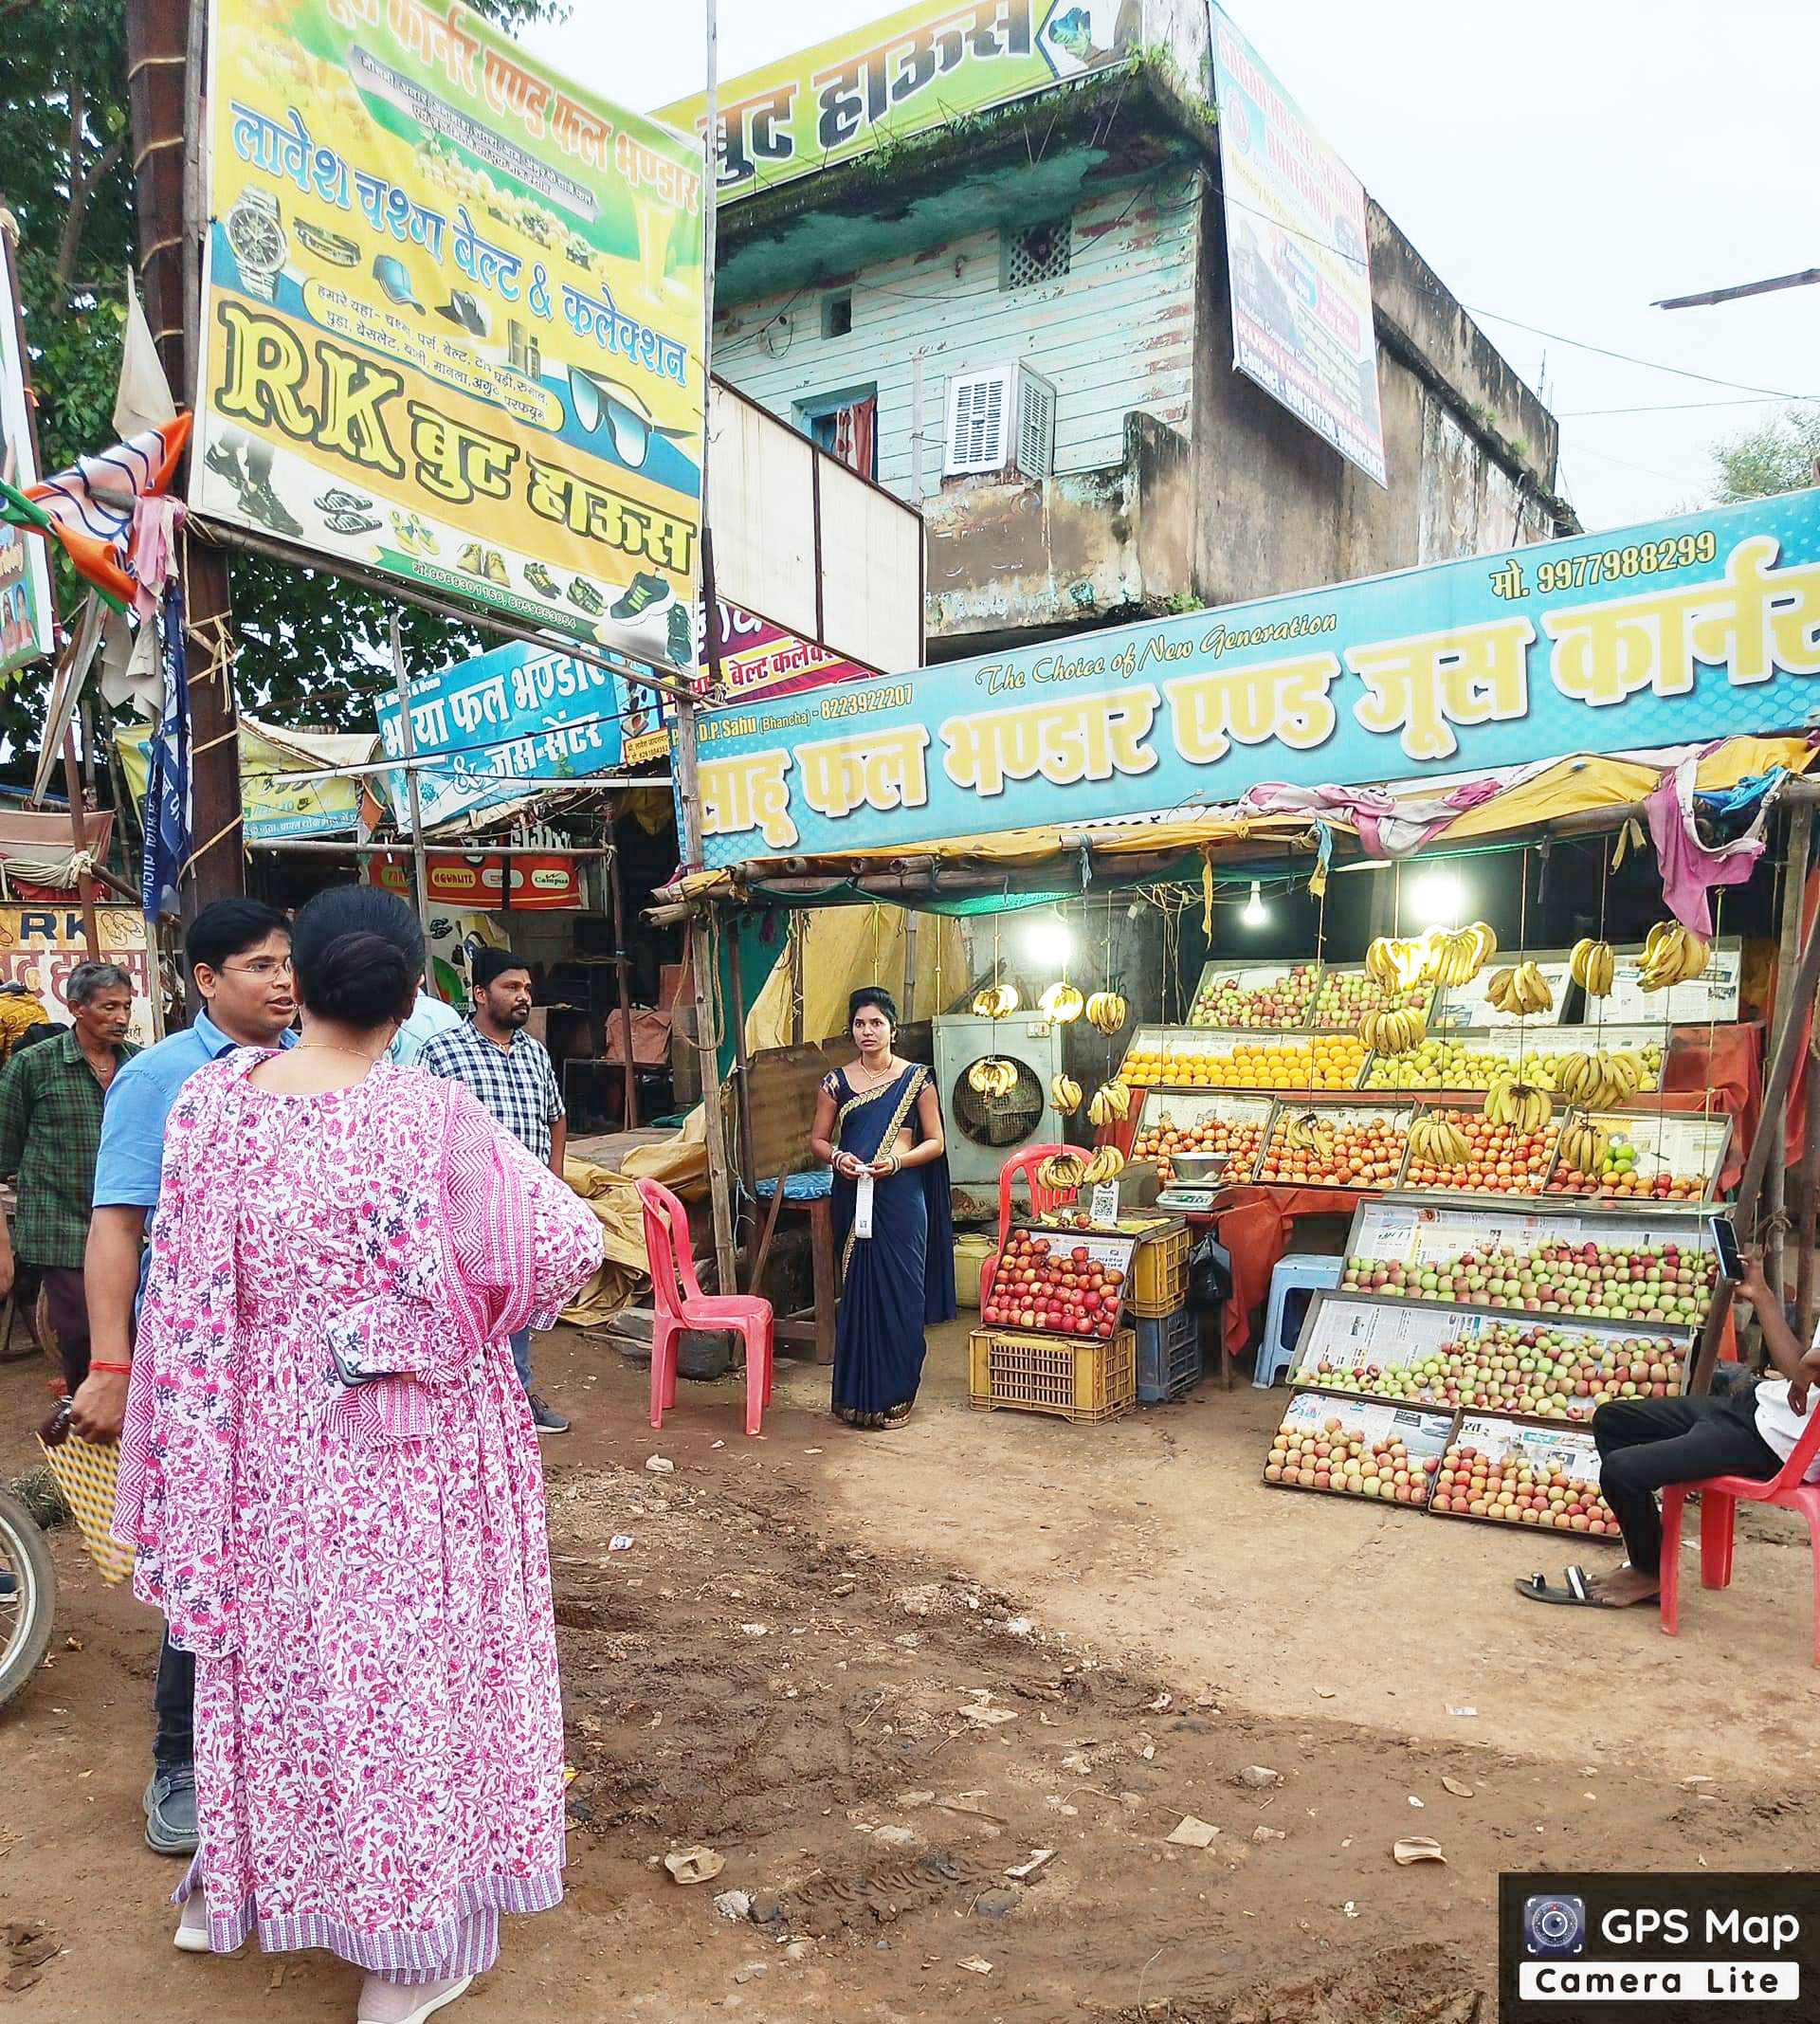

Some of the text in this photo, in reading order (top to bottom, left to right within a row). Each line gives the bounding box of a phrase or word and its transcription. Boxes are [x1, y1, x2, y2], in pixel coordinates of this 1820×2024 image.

[484, 46, 554, 140] एण्ड
[550, 93, 613, 173] फल
[616, 131, 700, 215] भण्डार
[229, 98, 688, 386] लावेश चश्मा बेल्ट & कलेक्शन
[318, 284, 347, 307] हमारे
[216, 301, 697, 574] RK बुट हाऊस
[1489, 530, 1717, 600] मो. 9977988299
[448, 674, 507, 734] फल
[511, 643, 606, 710] भण्डार
[729, 660, 769, 685] बेल्ट
[792, 722, 932, 818] फल
[938, 683, 1163, 797] भण्डार
[1164, 652, 1342, 764] एण्ड
[1344, 615, 1537, 760] जूस
[1541, 535, 1820, 707] कार्नर
[975, 611, 1338, 695] The Choice of New Generation
[698, 721, 721, 743] D.P.
[722, 716, 756, 738] Sahu
[758, 709, 811, 735] (Bhancha)
[820, 684, 913, 720] 8223922207
[453, 755, 484, 794] &
[21, 912, 86, 939] RK
